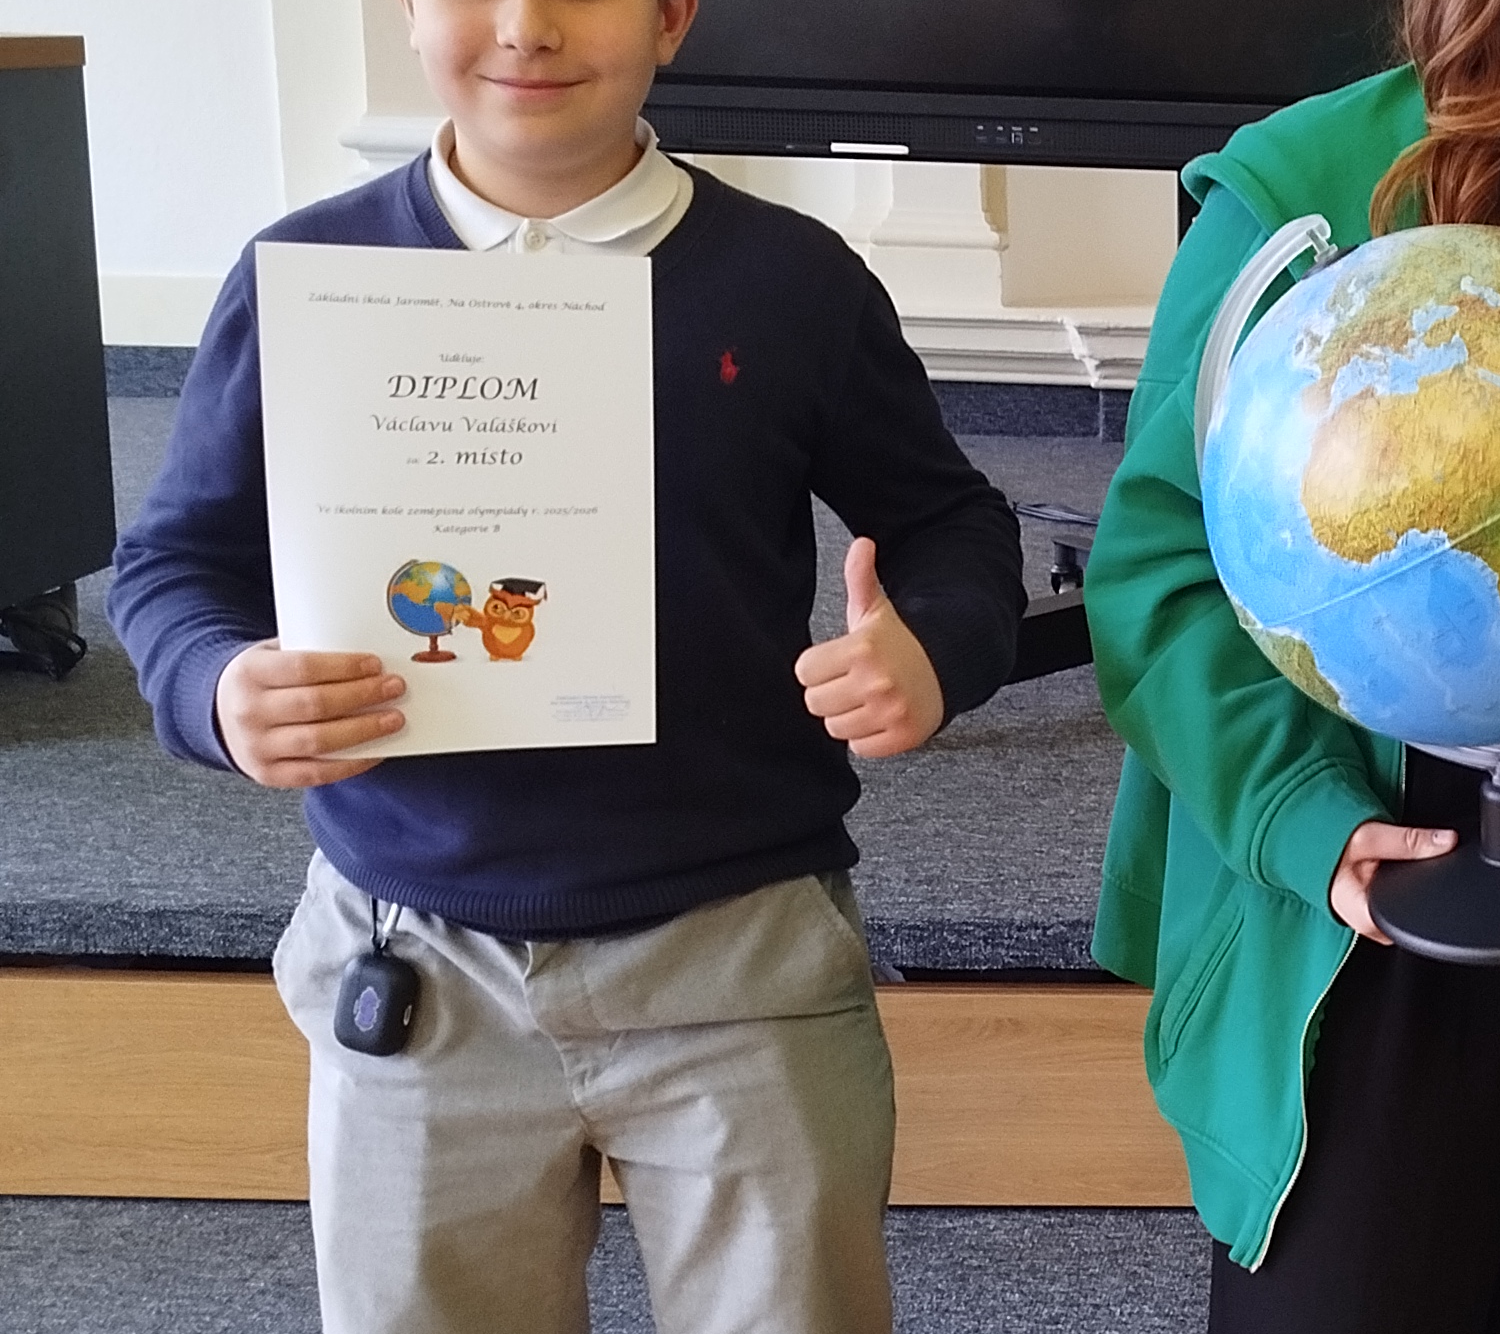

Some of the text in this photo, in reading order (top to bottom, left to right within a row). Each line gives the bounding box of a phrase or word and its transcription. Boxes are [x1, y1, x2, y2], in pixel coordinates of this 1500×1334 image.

[447, 298, 465, 308] Na
[528, 300, 558, 310] okres
[387, 374, 539, 401] DIPLOM
[371, 414, 558, 434] Václavu Valáškovi
[426, 451, 445, 465] 2.
[456, 447, 524, 465] místo
[432, 524, 489, 536] Kategorie
